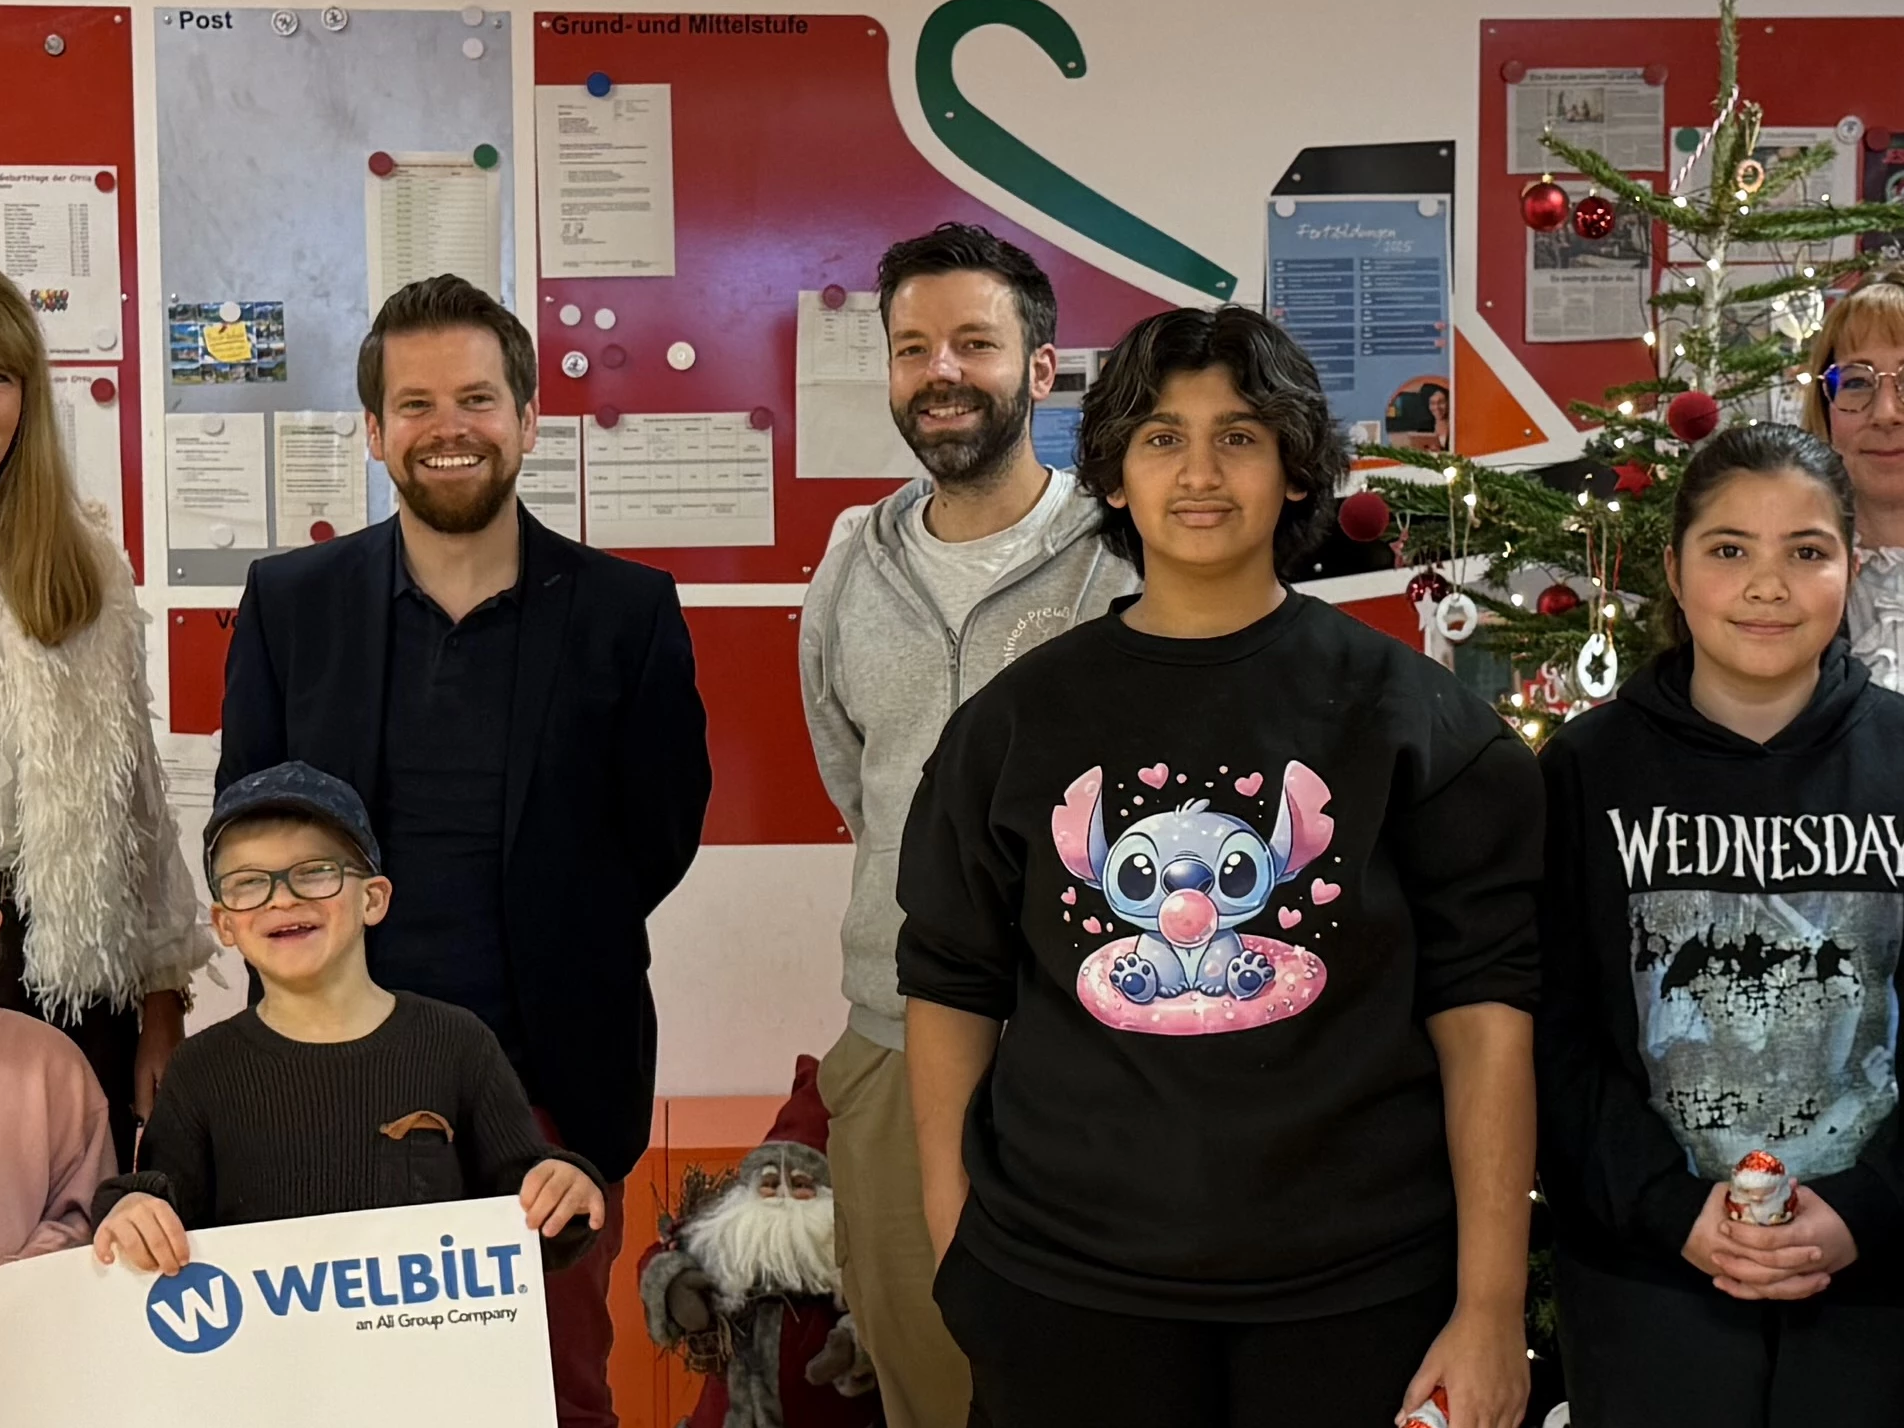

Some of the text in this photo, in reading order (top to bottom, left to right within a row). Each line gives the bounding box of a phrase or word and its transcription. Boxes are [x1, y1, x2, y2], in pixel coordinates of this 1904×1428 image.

[179, 10, 233, 30] Post
[551, 14, 809, 35] Grund- und Mittelstufe
[355, 1318, 374, 1331] an
[398, 1313, 444, 1330] Group
[447, 1307, 518, 1326] Company
